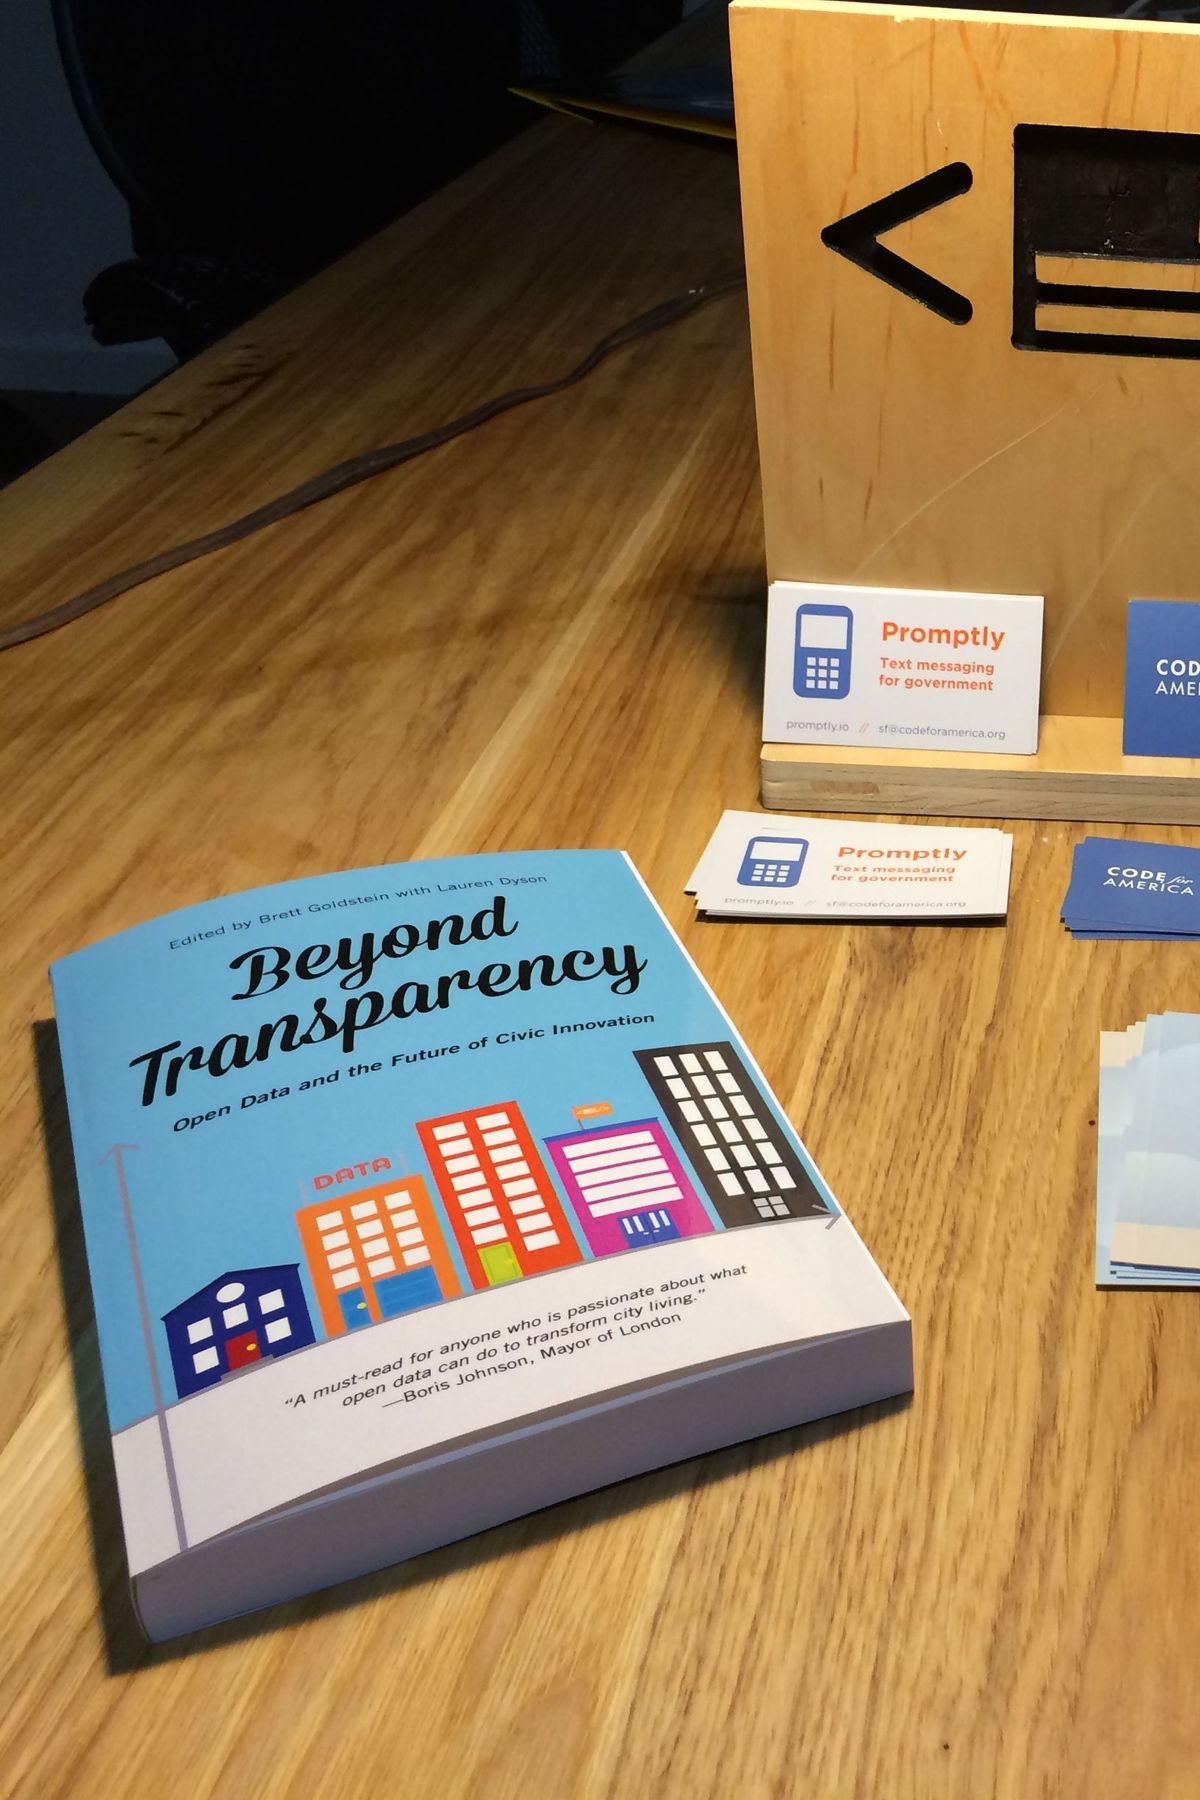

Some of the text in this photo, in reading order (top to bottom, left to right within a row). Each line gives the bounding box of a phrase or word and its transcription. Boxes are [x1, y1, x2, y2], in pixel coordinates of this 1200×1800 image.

[882, 621, 1006, 650] Promptly
[880, 657, 994, 676] Text messaging
[879, 674, 994, 691] for government
[786, 719, 850, 733] promptly.io
[878, 724, 1006, 740] sf@codeforamerica.org
[838, 847, 967, 861] Promptly
[859, 875, 954, 883] government
[873, 866, 956, 874] messaging
[1107, 866, 1194, 885] CODE for
[1103, 878, 1194, 896] AMERICA
[169, 875, 548, 950] Edited by Brett Goldstein with Lauren Dyson
[229, 895, 519, 1001] Beyond
[129, 943, 648, 1107] Transparency
[173, 1013, 655, 1132] Open Data and the Future of Civic Innovation
[313, 1157, 392, 1190] DATA
[313, 1357, 403, 1399] must-read
[410, 1349, 433, 1365] for
[440, 1328, 501, 1354] anyone
[507, 1317, 541, 1334] who
[548, 1311, 561, 1323] is
[567, 1287, 655, 1320] passionate
[660, 1274, 705, 1293] about
[710, 1264, 747, 1281] what
[342, 1385, 386, 1407] open
[393, 1368, 432, 1387] data
[438, 1356, 469, 1374] can
[476, 1348, 498, 1361] do
[503, 1339, 520, 1353] to
[526, 1316, 607, 1346] transform
[613, 1304, 643, 1322] city
[456, 1356, 534, 1386] Johnson,
[540, 1337, 591, 1360] Mayor
[597, 1328, 613, 1342] of
[620, 1312, 682, 1336] London
